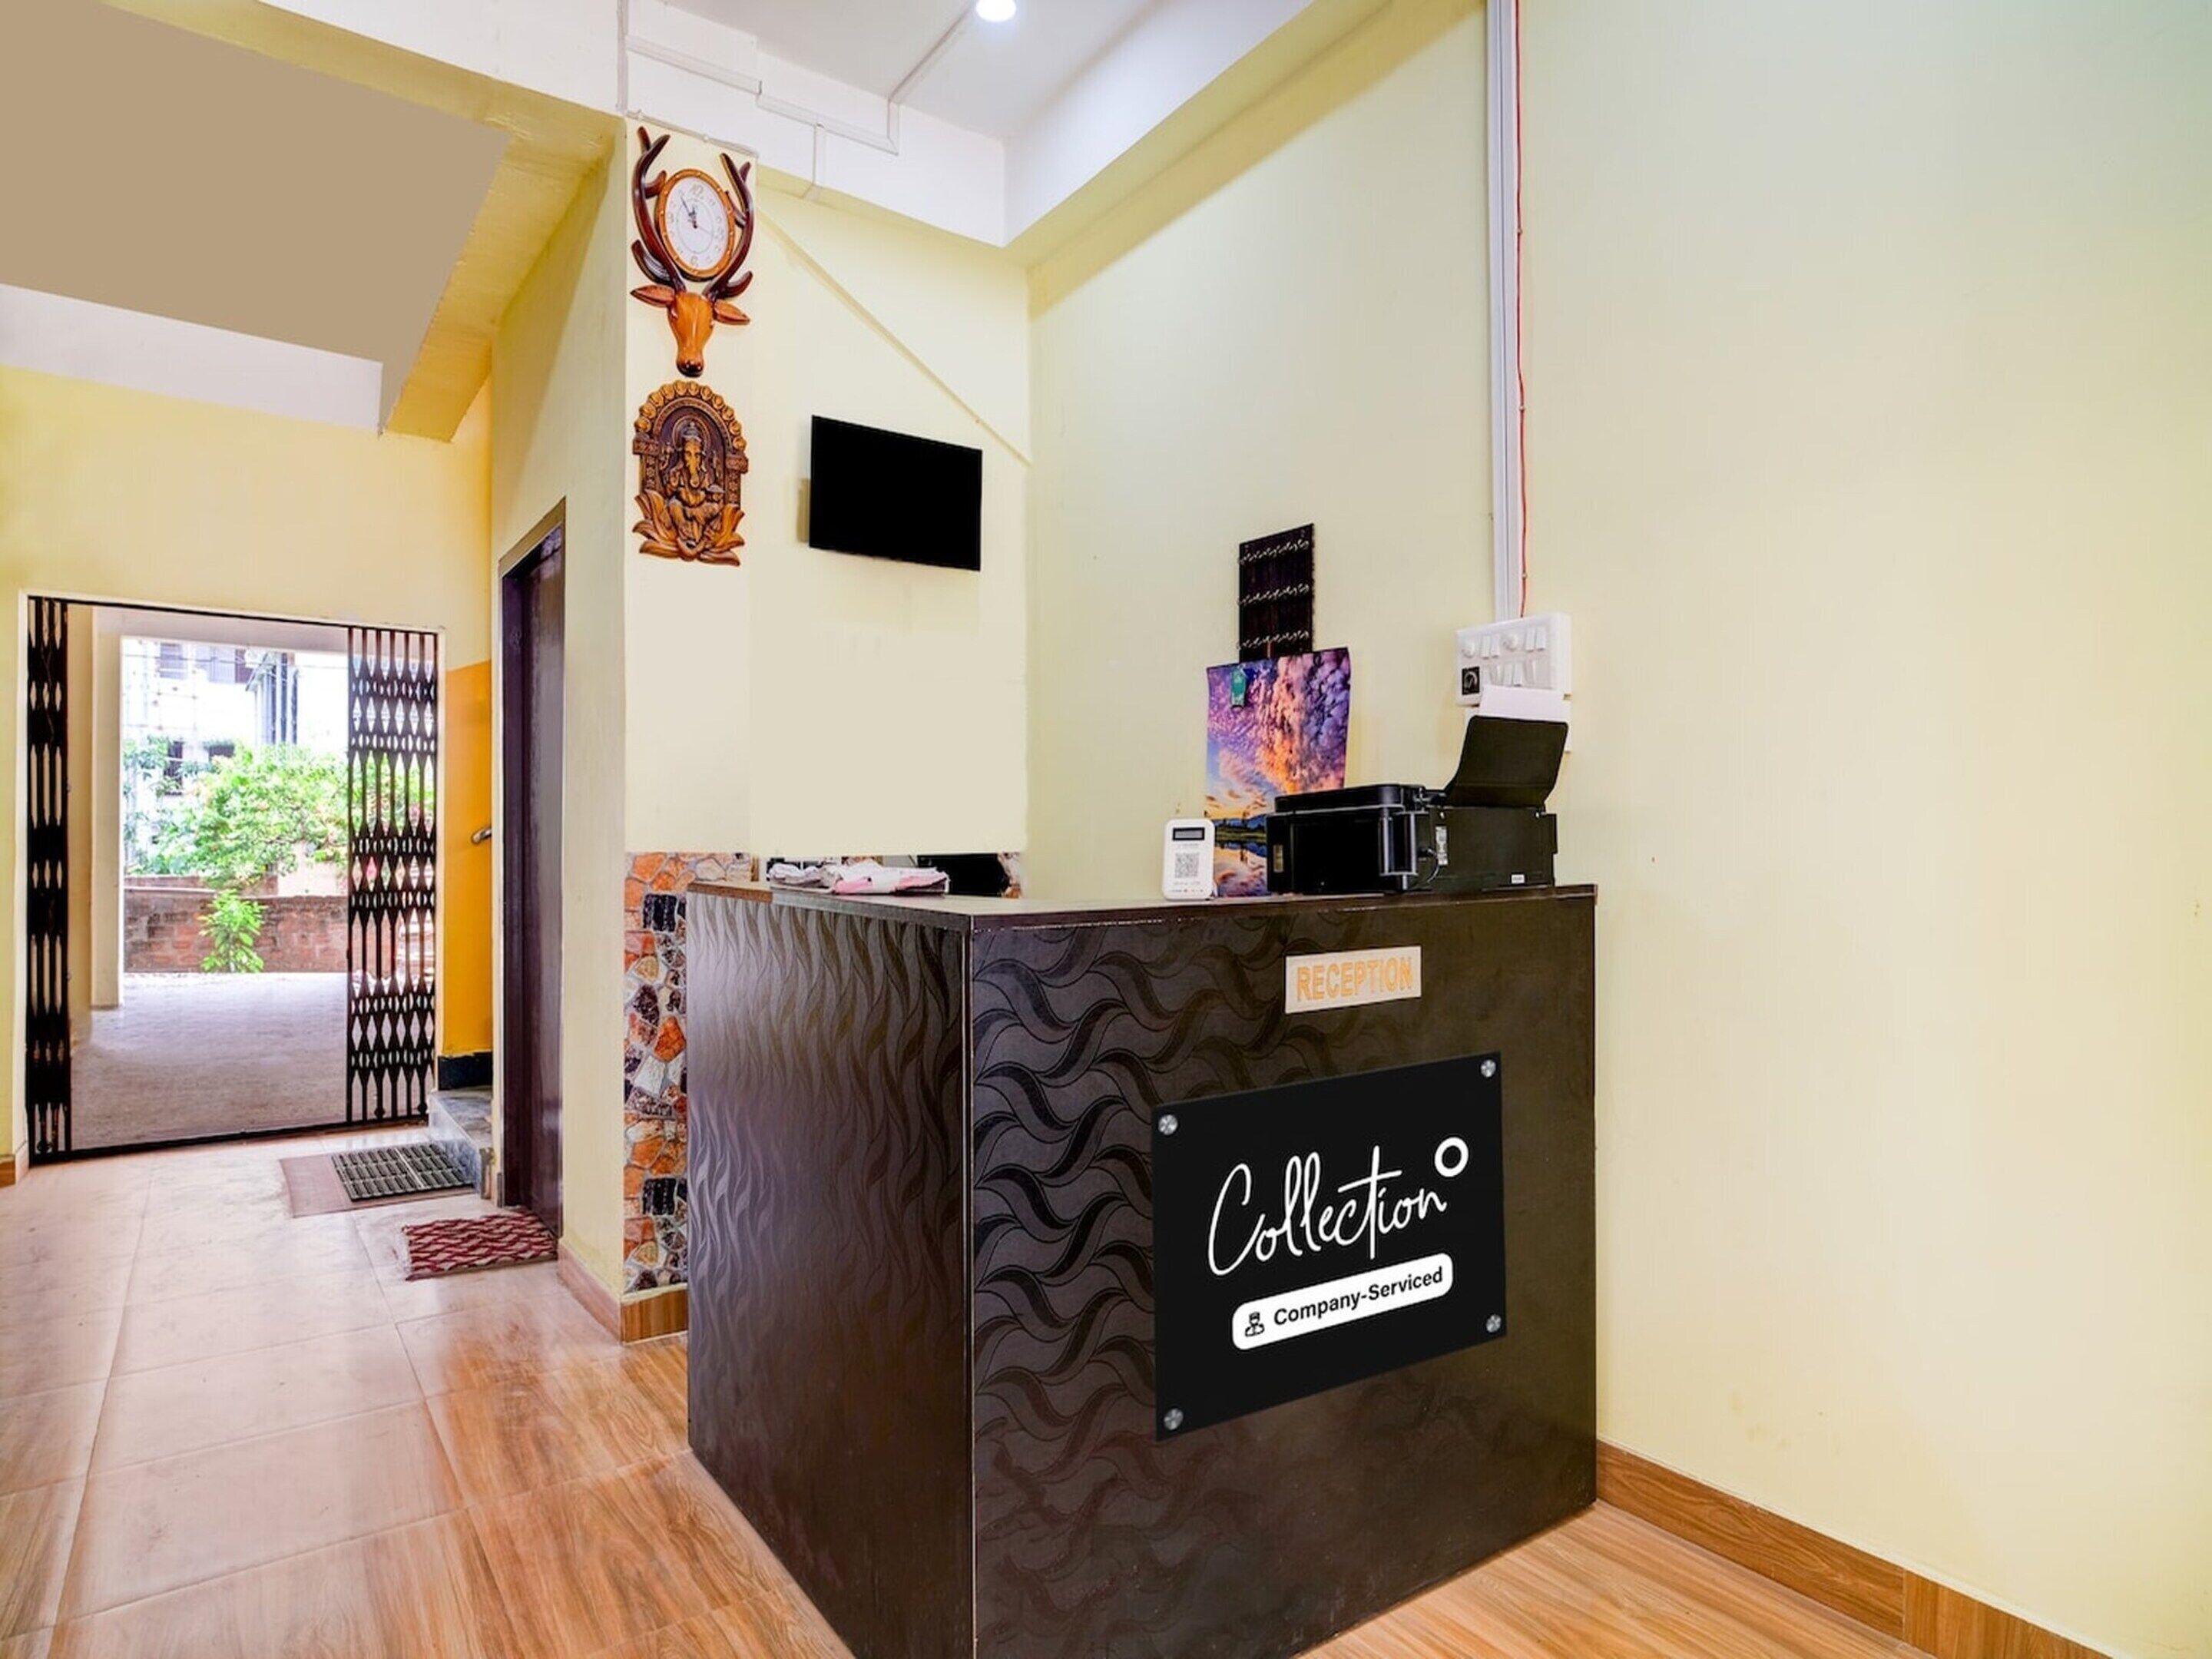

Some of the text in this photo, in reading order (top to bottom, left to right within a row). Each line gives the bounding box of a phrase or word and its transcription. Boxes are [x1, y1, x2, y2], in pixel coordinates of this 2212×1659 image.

[1296, 956, 1413, 1002] RECEPTION
[1207, 1145, 1447, 1276] Collection
[1273, 1266, 1443, 1326] Company-Serviced
